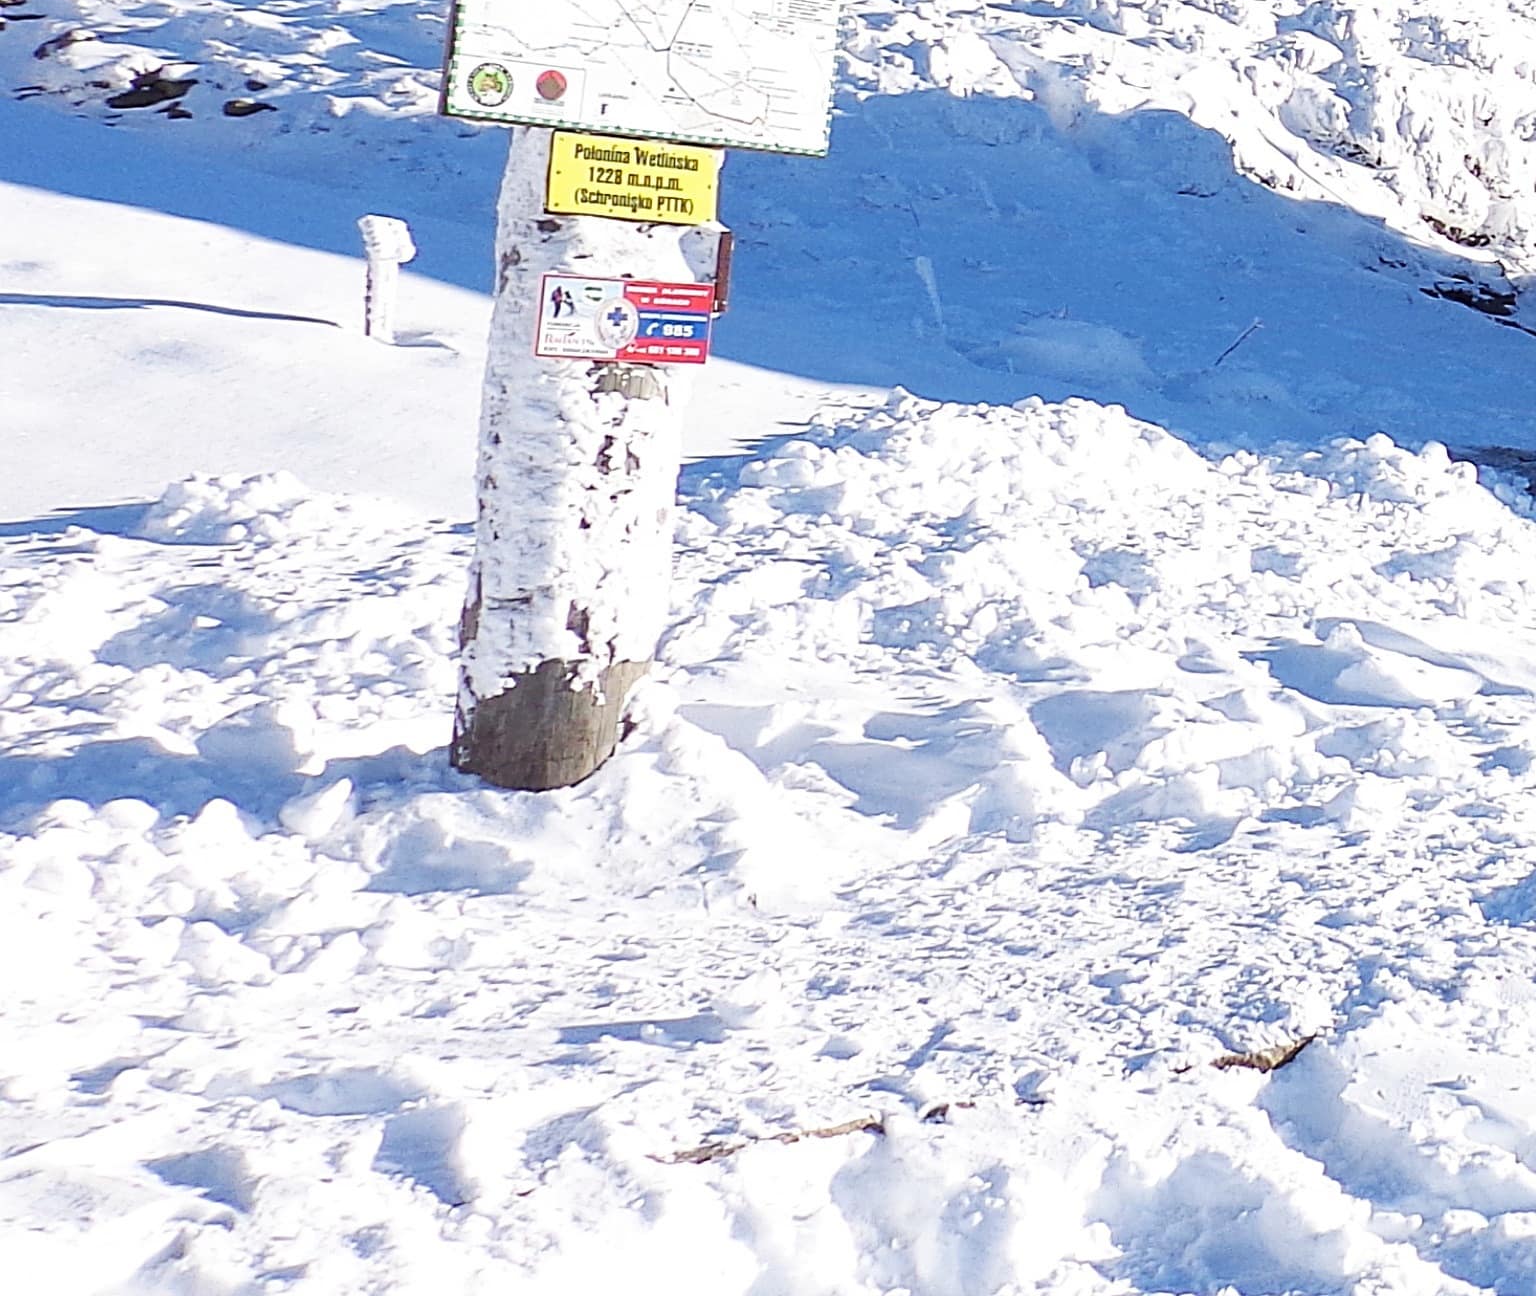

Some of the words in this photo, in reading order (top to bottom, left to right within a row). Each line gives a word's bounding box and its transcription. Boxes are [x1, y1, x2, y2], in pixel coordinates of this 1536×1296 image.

[574, 143, 631, 164] Połonina
[634, 146, 699, 171] Wetlińska
[589, 166, 623, 185] 1228
[574, 187, 653, 210] (Schronisko
[657, 195, 694, 216] PTTK)
